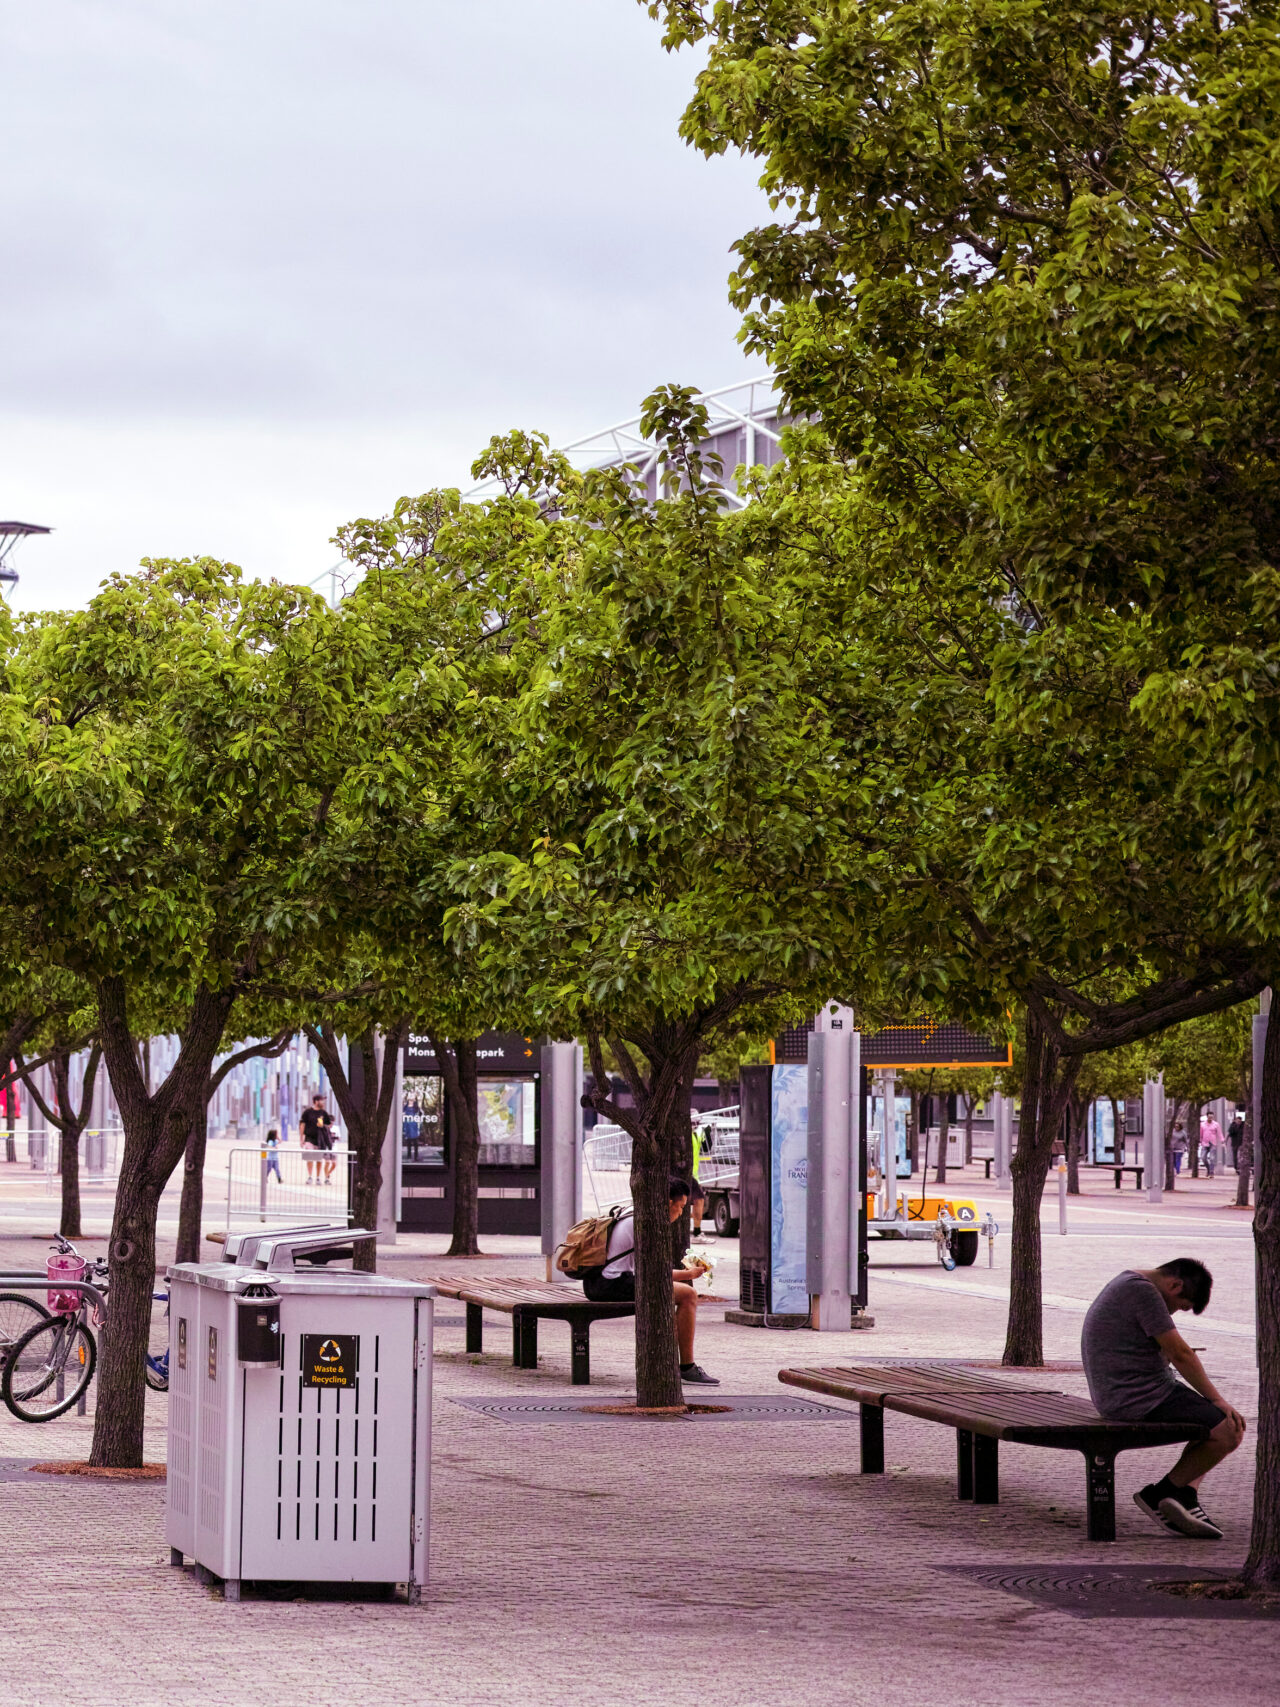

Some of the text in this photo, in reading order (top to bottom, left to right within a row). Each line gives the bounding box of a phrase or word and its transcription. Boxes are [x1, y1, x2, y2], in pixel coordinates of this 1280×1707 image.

[402, 1114, 438, 1124] merse
[787, 1169, 808, 1179] FRAN
[961, 1209, 971, 1218] A
[314, 1365, 345, 1373] Waste &
[311, 1375, 347, 1385] Recycling
[1094, 1487, 1109, 1495] 16A
